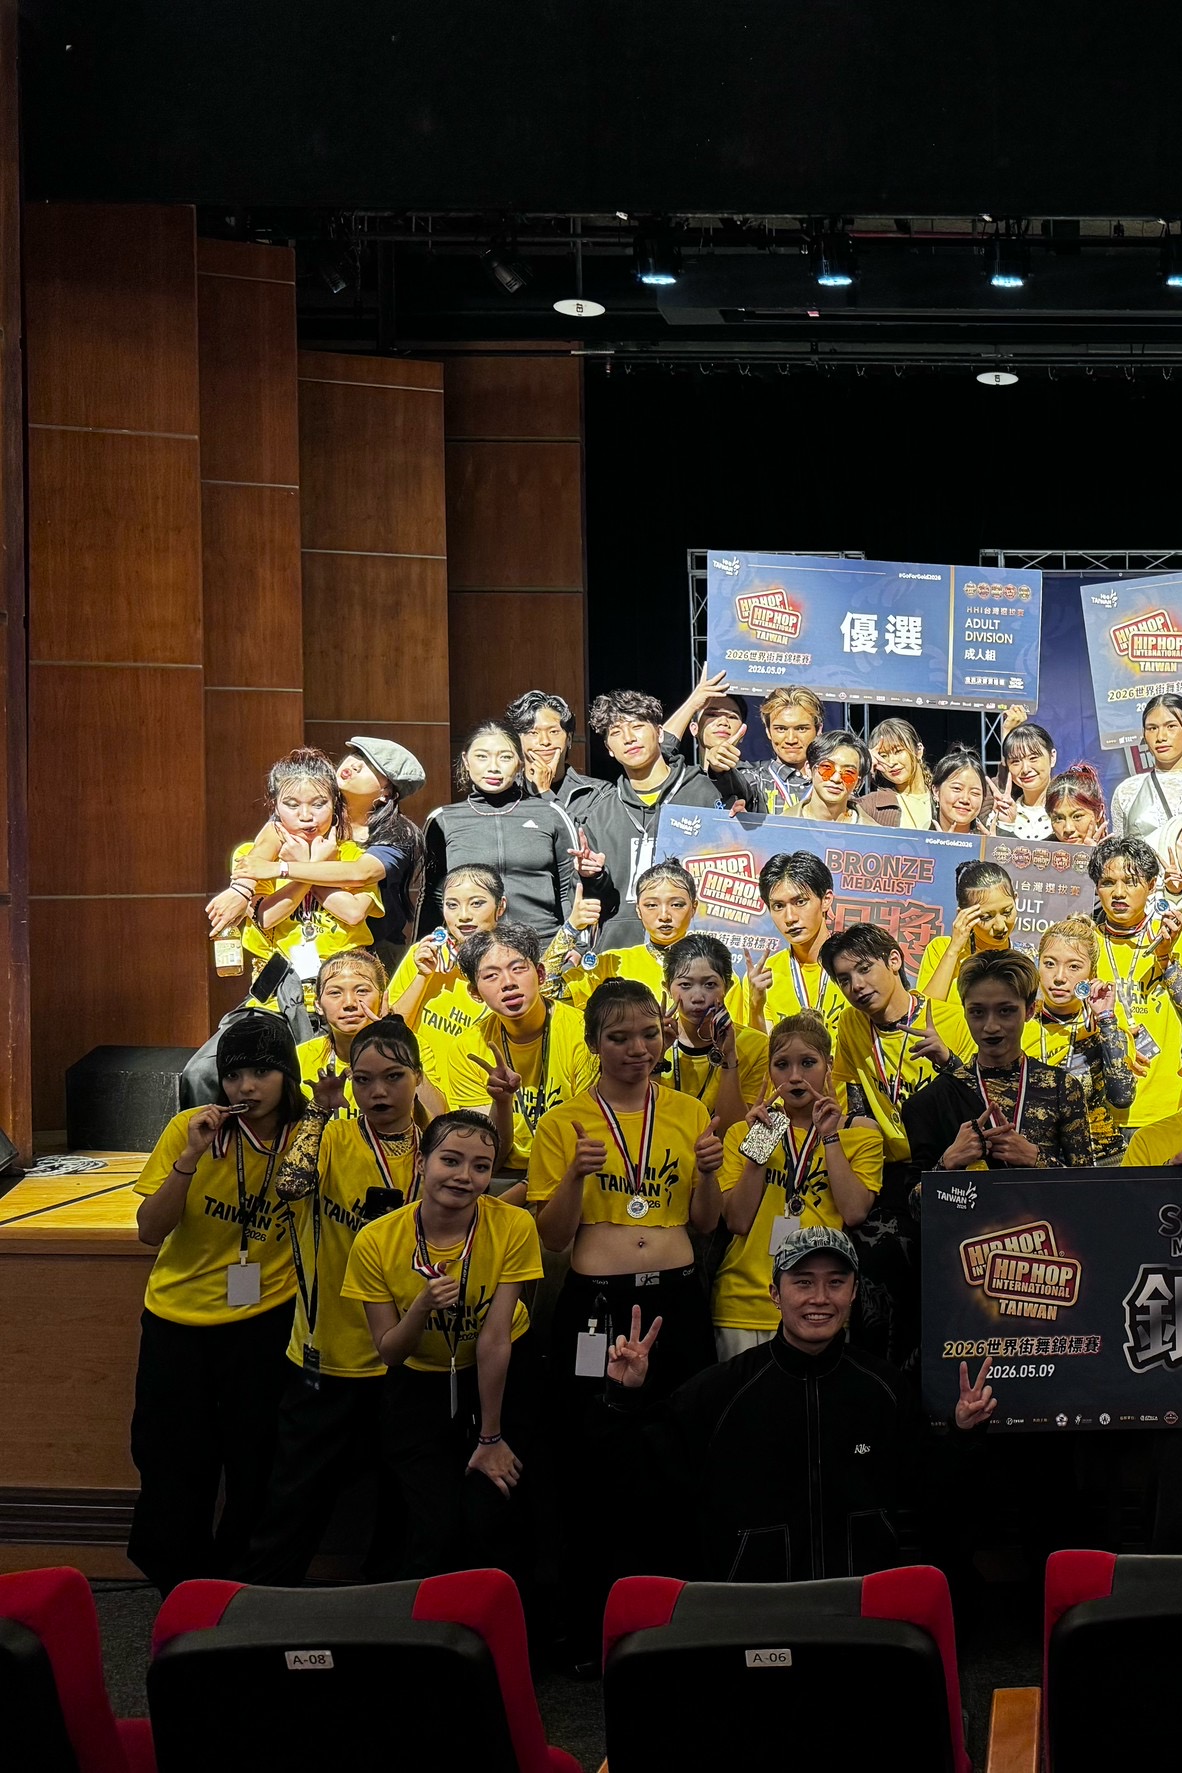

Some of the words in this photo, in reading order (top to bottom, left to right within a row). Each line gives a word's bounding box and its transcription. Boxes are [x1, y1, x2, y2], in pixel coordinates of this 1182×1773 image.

[752, 620, 796, 633] INTERNATIONAL
[754, 608, 774, 623] HIP
[774, 612, 797, 627] HOP
[965, 618, 1000, 630] ADULT
[756, 630, 788, 645] TAIWAN
[840, 611, 923, 656] 優選
[965, 632, 1013, 644] DIVISION
[1134, 636, 1158, 650] HIP
[964, 649, 996, 662] 成人組
[1140, 662, 1177, 672] TAIWAN
[826, 848, 936, 882] BRONZE
[706, 875, 732, 895] HIP
[841, 875, 916, 895] MEDALIST
[703, 889, 762, 910] INTERNATIONAL
[706, 904, 750, 924] TAIWAN
[450, 1006, 471, 1027] HHI
[1132, 1006, 1148, 1014] 2026
[596, 1173, 660, 1197] TAIWAN
[951, 1186, 966, 1196] HHI
[936, 1190, 968, 1204] TAIWAN
[204, 1195, 272, 1230] TAIWAN
[244, 1228, 267, 1242] 2026
[1004, 1230, 1047, 1256] HOP
[994, 1258, 1030, 1281] HIP
[1030, 1264, 1073, 1286] HOP
[992, 1278, 1070, 1298] INTERNATIONAL
[999, 1299, 1058, 1320] TAIWAN
[942, 1335, 1100, 1358] 2026世界街舞錦標賽
[986, 1364, 1055, 1378] 2026.05.09
[293, 1654, 326, 1666] A-08
[752, 1652, 786, 1663] A-06
